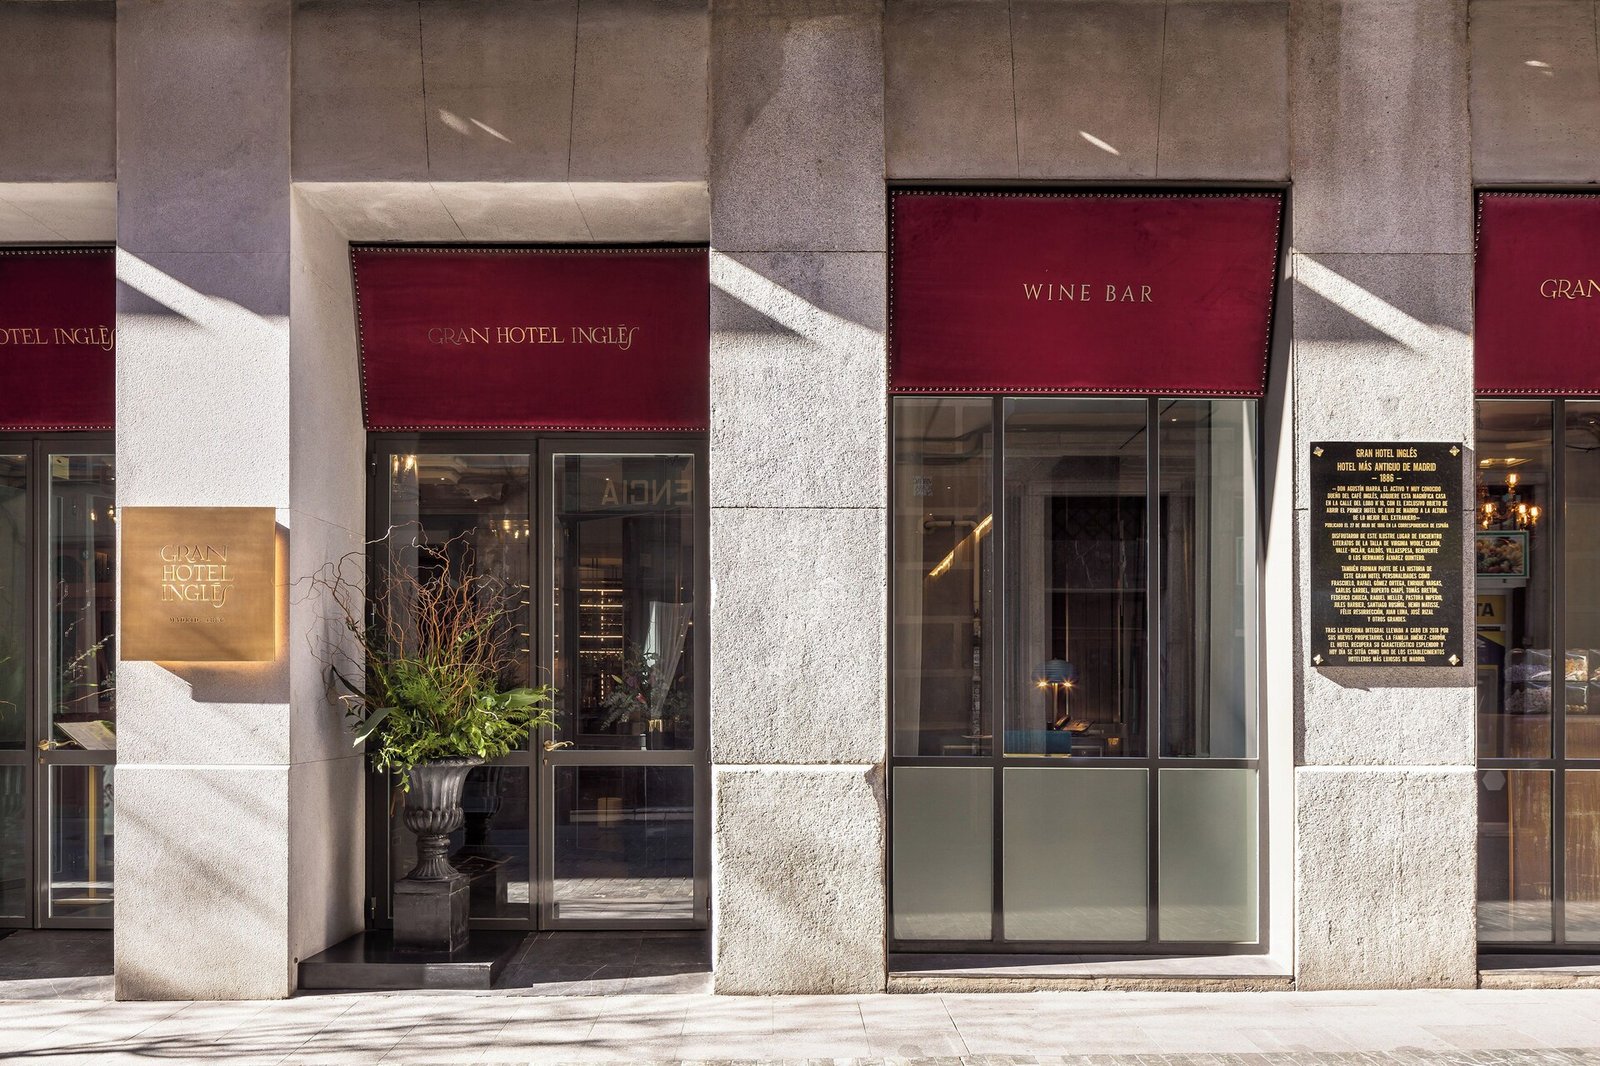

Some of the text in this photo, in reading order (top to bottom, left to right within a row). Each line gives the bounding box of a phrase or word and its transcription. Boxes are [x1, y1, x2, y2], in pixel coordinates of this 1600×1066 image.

[1023, 283, 1153, 303] WINE BAR
[428, 323, 640, 351] GRAN HOTEL INGLÉS
[1356, 447, 1418, 458] GRAN HOTEL INGLÉS
[1337, 461, 1437, 472] HOTEL MÁS ANTIGUO DE MADRID
[1380, 473, 1394, 482] 1886
[159, 544, 230, 564] GRAN
[161, 564, 235, 582] HOTEL
[161, 582, 235, 608] INGLÉS
